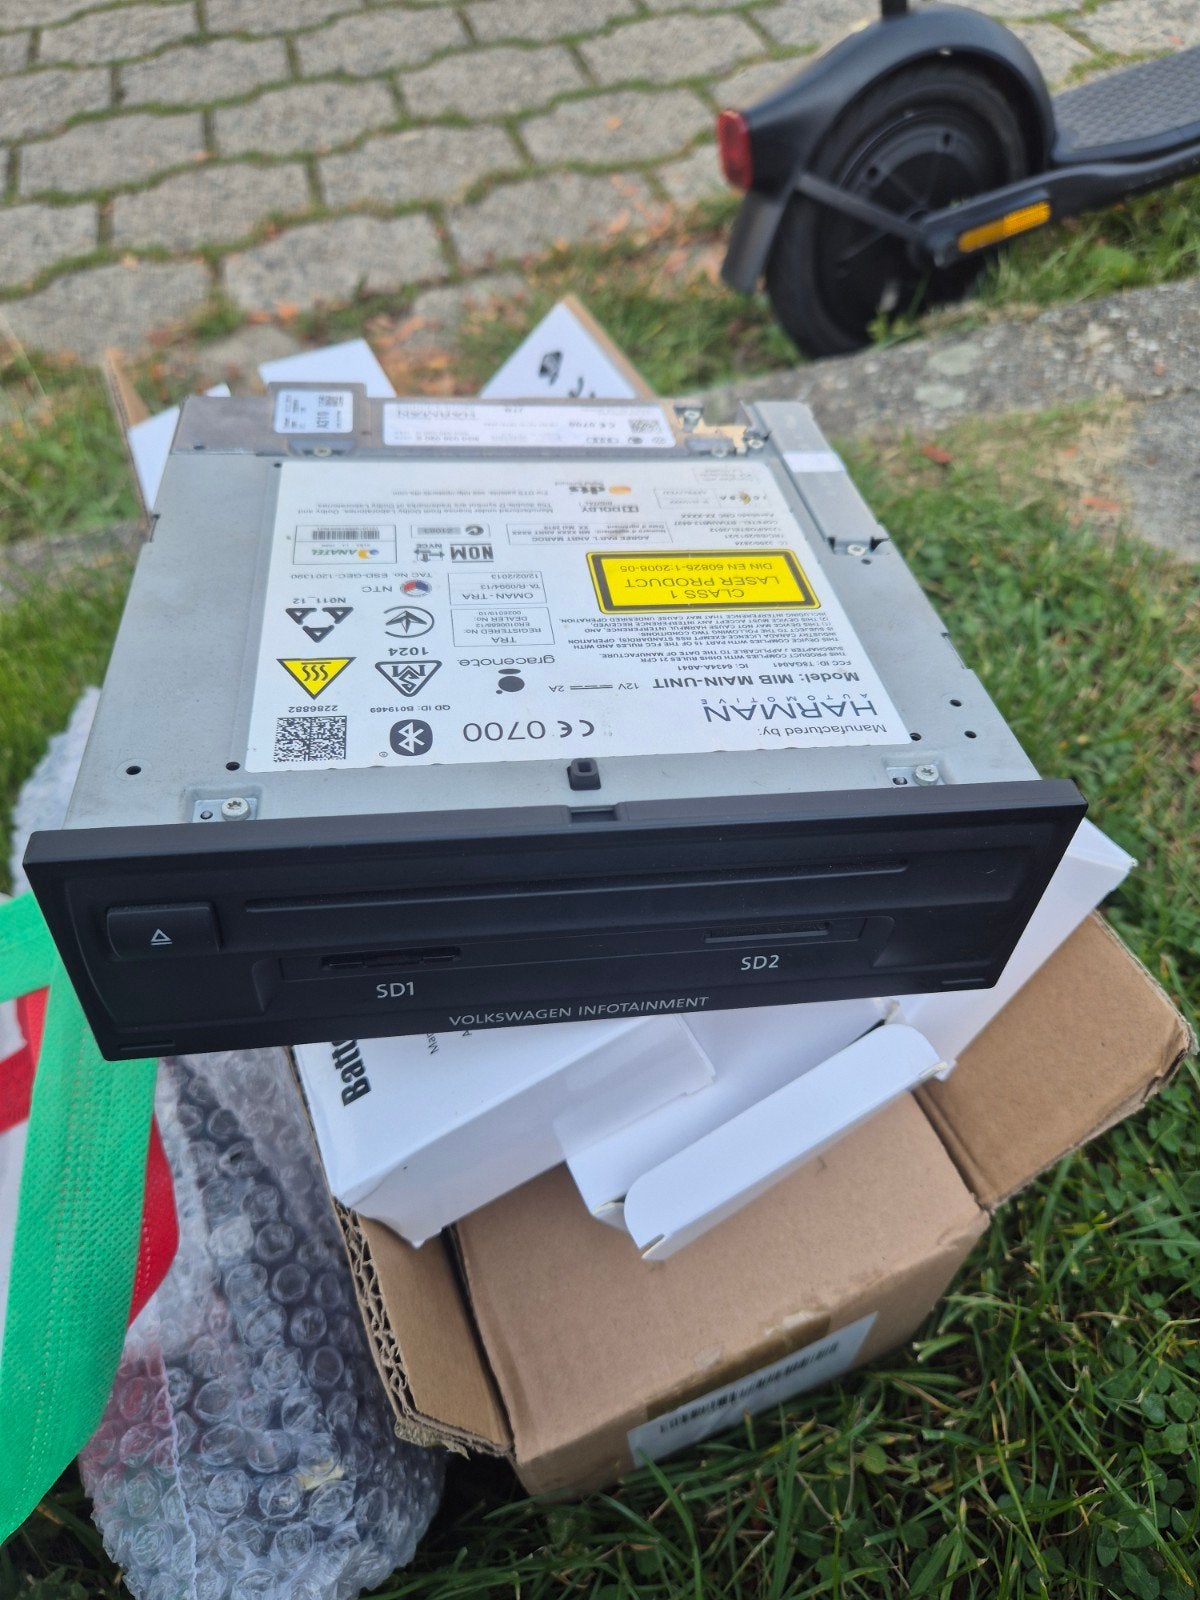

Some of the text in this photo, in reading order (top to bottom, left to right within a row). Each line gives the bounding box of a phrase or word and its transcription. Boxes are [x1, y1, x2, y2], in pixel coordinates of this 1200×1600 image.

[450, 546, 494, 560] NOM
[624, 575, 779, 588] LASER PRODUCT
[670, 588, 744, 598] CLASS 1
[388, 646, 428, 656] 1024
[652, 672, 859, 688] Model: MIB MAIN-UNIT
[700, 693, 868, 705] AUTOMOTIVE
[288, 704, 338, 713] 2286882
[369, 705, 414, 713] B019469
[703, 700, 878, 723] HARMAN
[462, 719, 546, 742] 0700
[757, 724, 887, 737] Manufactured by:
[741, 954, 779, 970] SD2
[376, 981, 414, 998] SD1
[449, 996, 709, 1026] VOLKSWAGEN INFOTAINMENT
